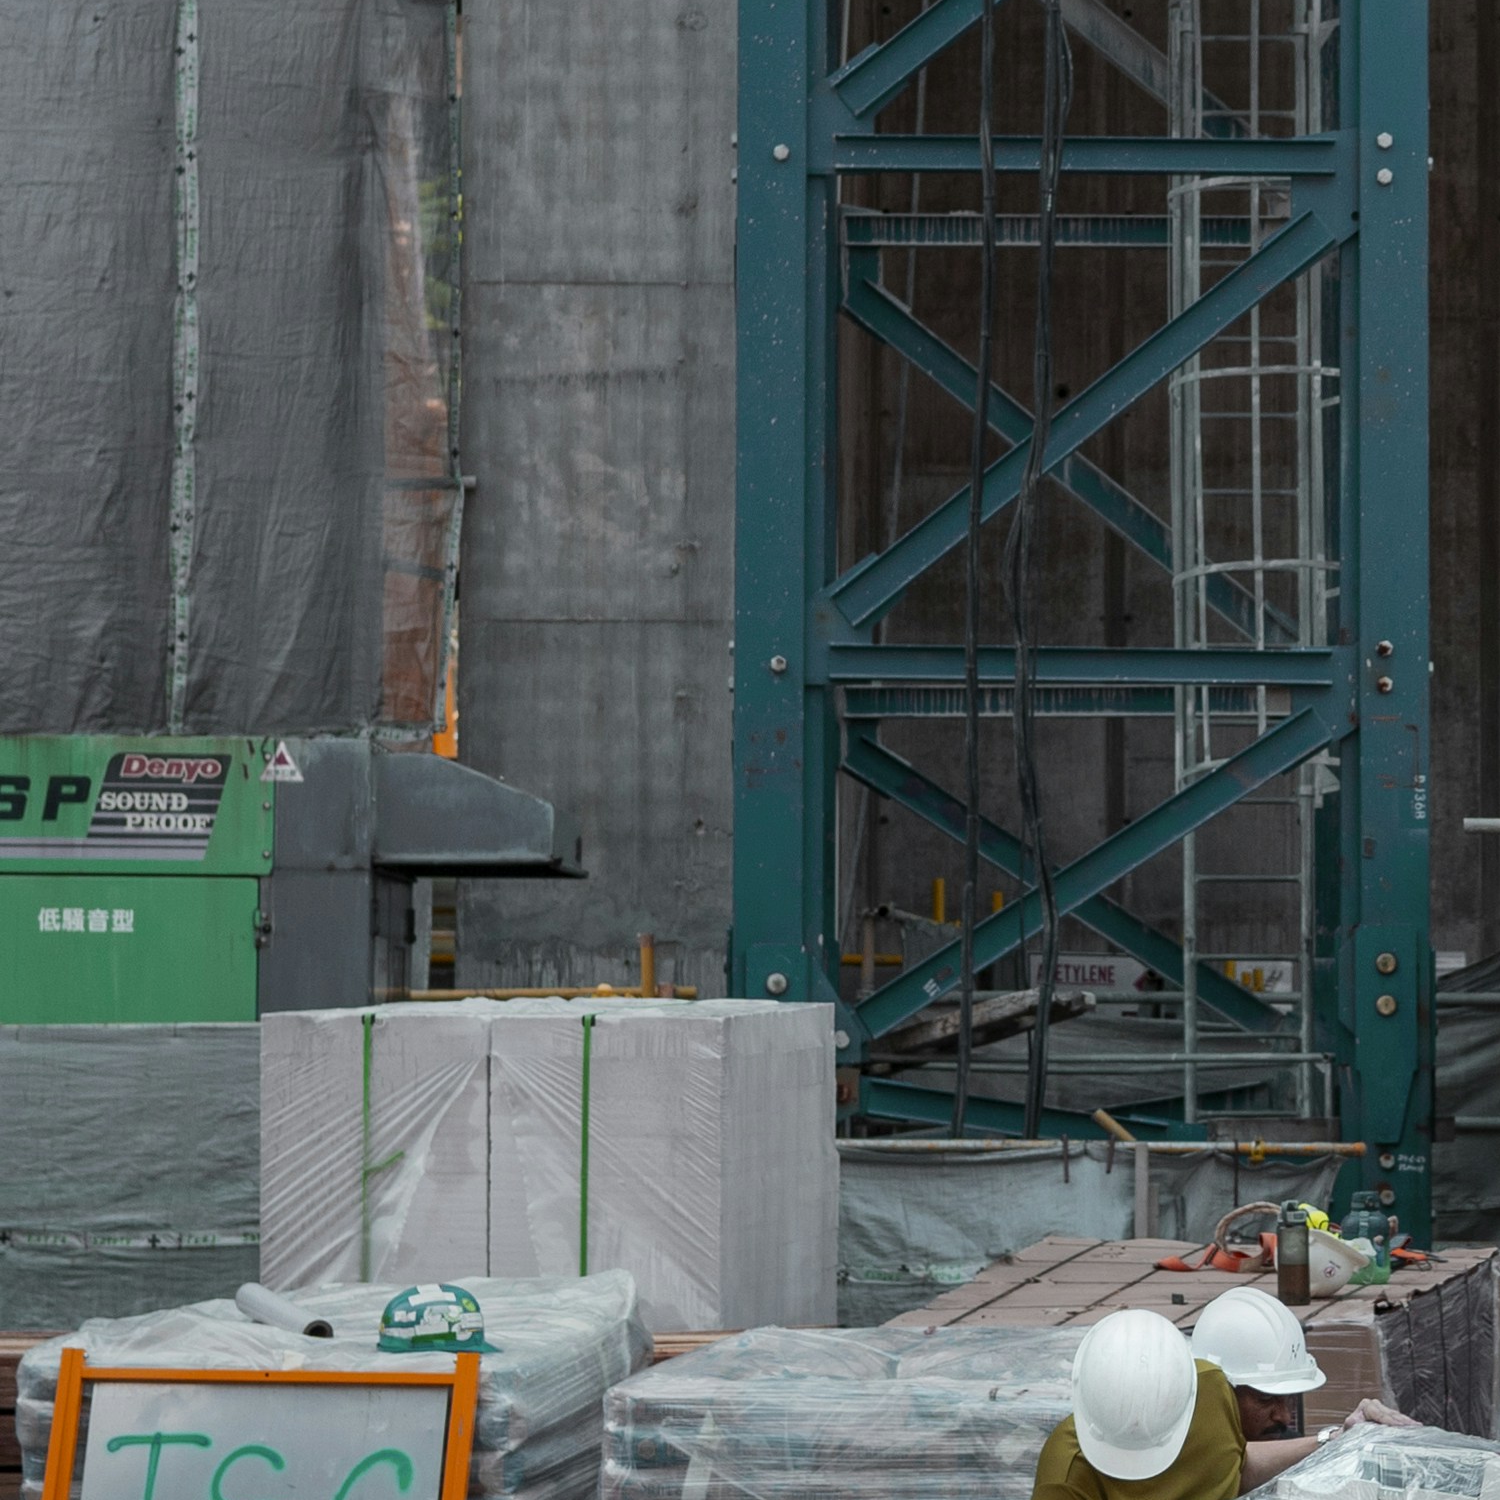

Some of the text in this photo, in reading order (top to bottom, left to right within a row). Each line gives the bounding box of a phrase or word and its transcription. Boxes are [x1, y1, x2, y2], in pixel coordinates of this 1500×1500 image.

[120, 753, 222, 784] Denyo
[100, 792, 188, 812] SOUND
[124, 813, 213, 831] PROOF
